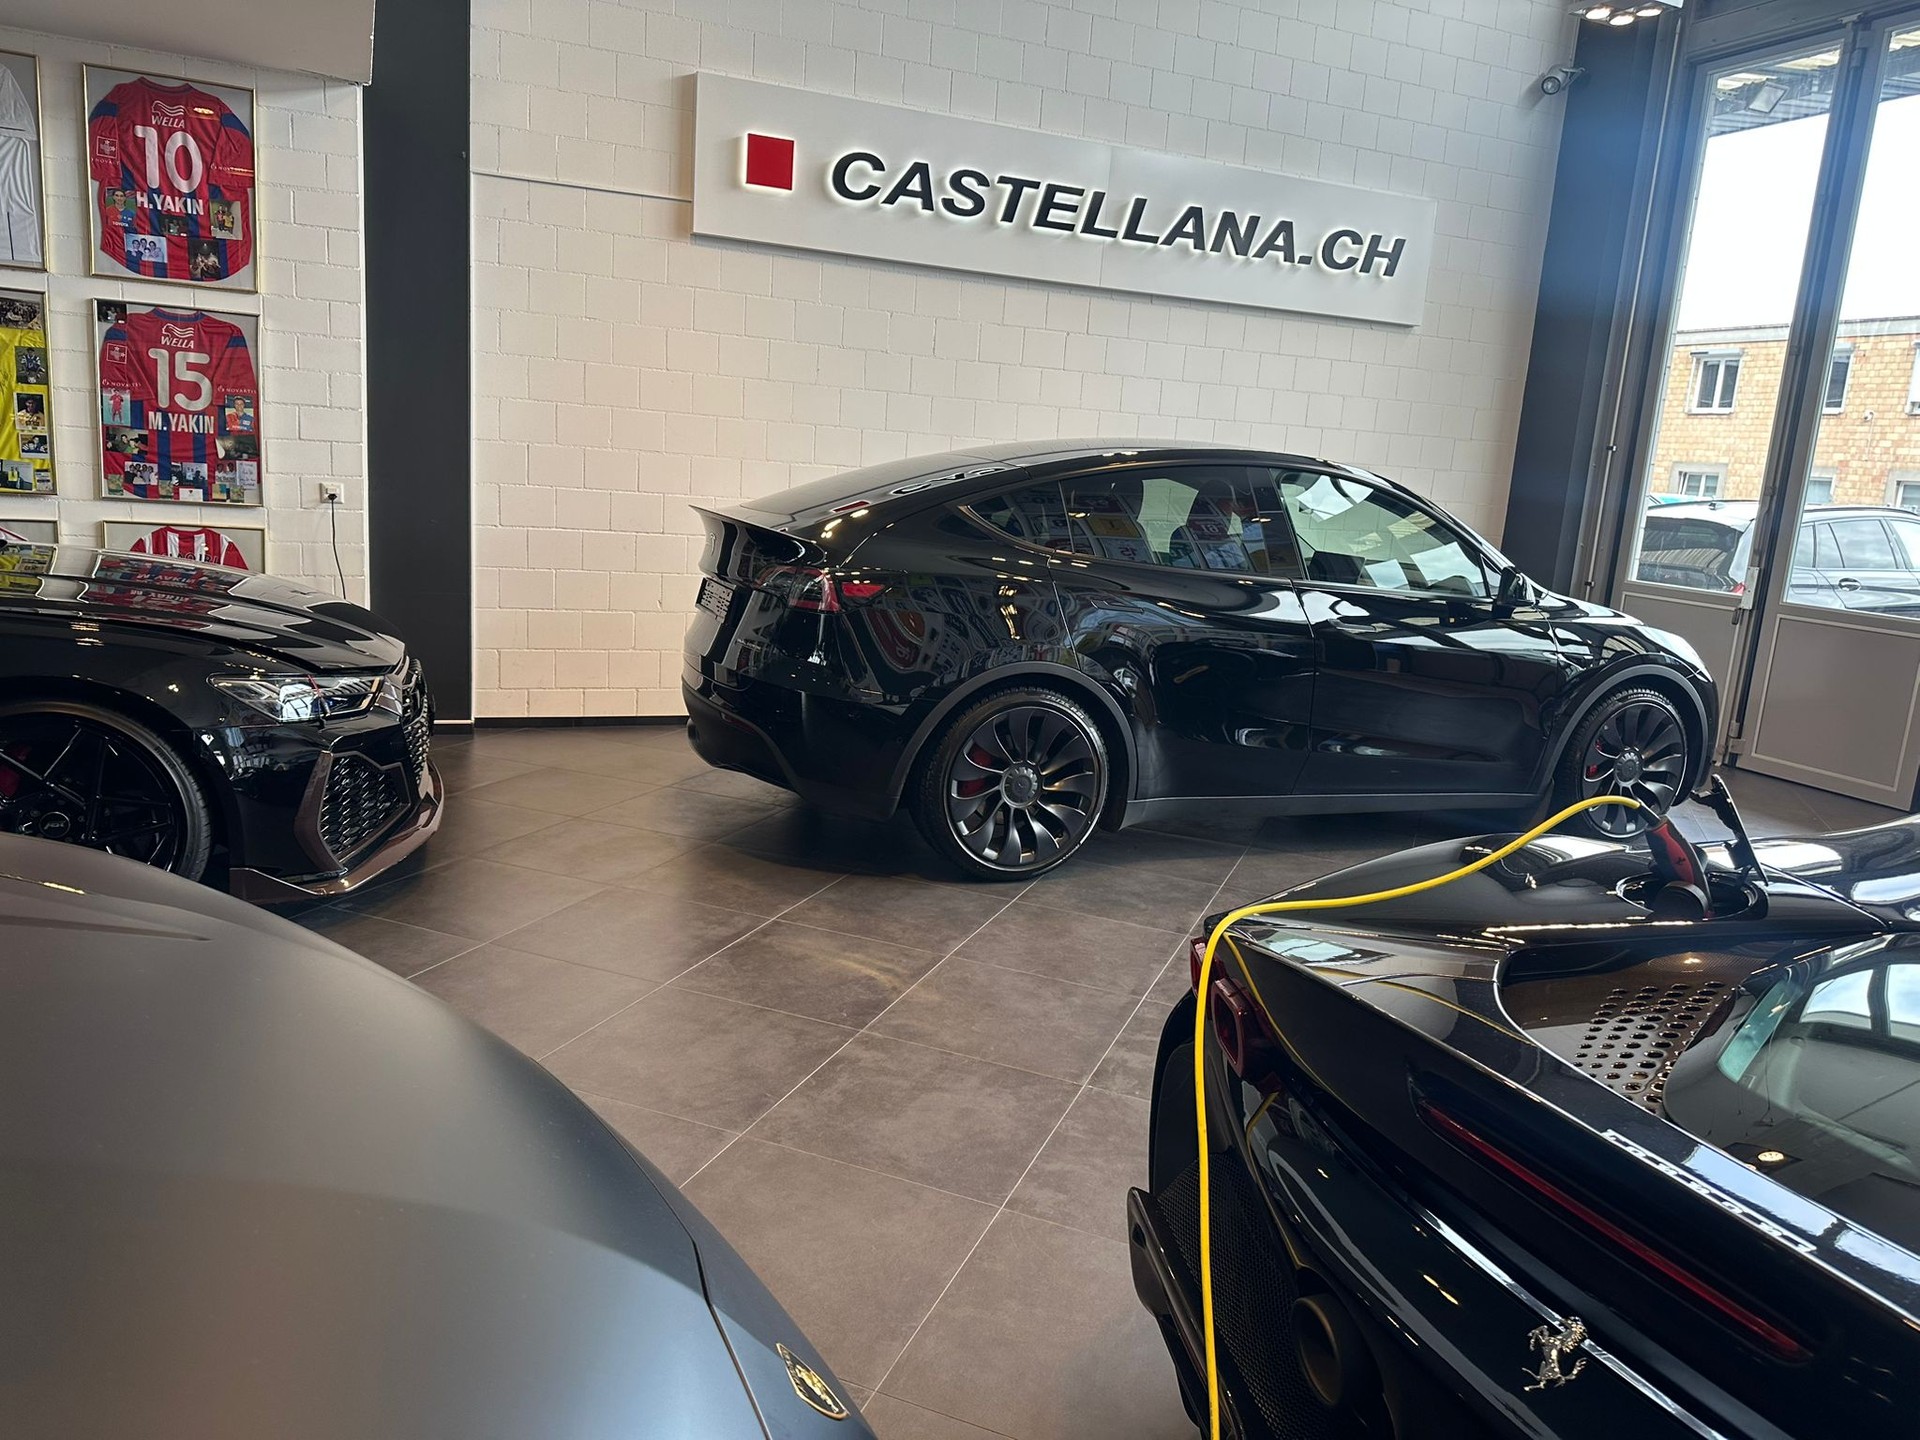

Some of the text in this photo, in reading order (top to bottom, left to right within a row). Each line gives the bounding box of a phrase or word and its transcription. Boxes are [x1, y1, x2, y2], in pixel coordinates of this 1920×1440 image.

[151, 115, 185, 129] WELLA
[134, 125, 203, 193] 10
[136, 191, 204, 215] H.YAKIN
[832, 152, 1407, 277] CASTELLANA.CH
[161, 336, 194, 349] WELLA
[148, 348, 212, 411] 15
[148, 411, 214, 434] M.YAKIN
